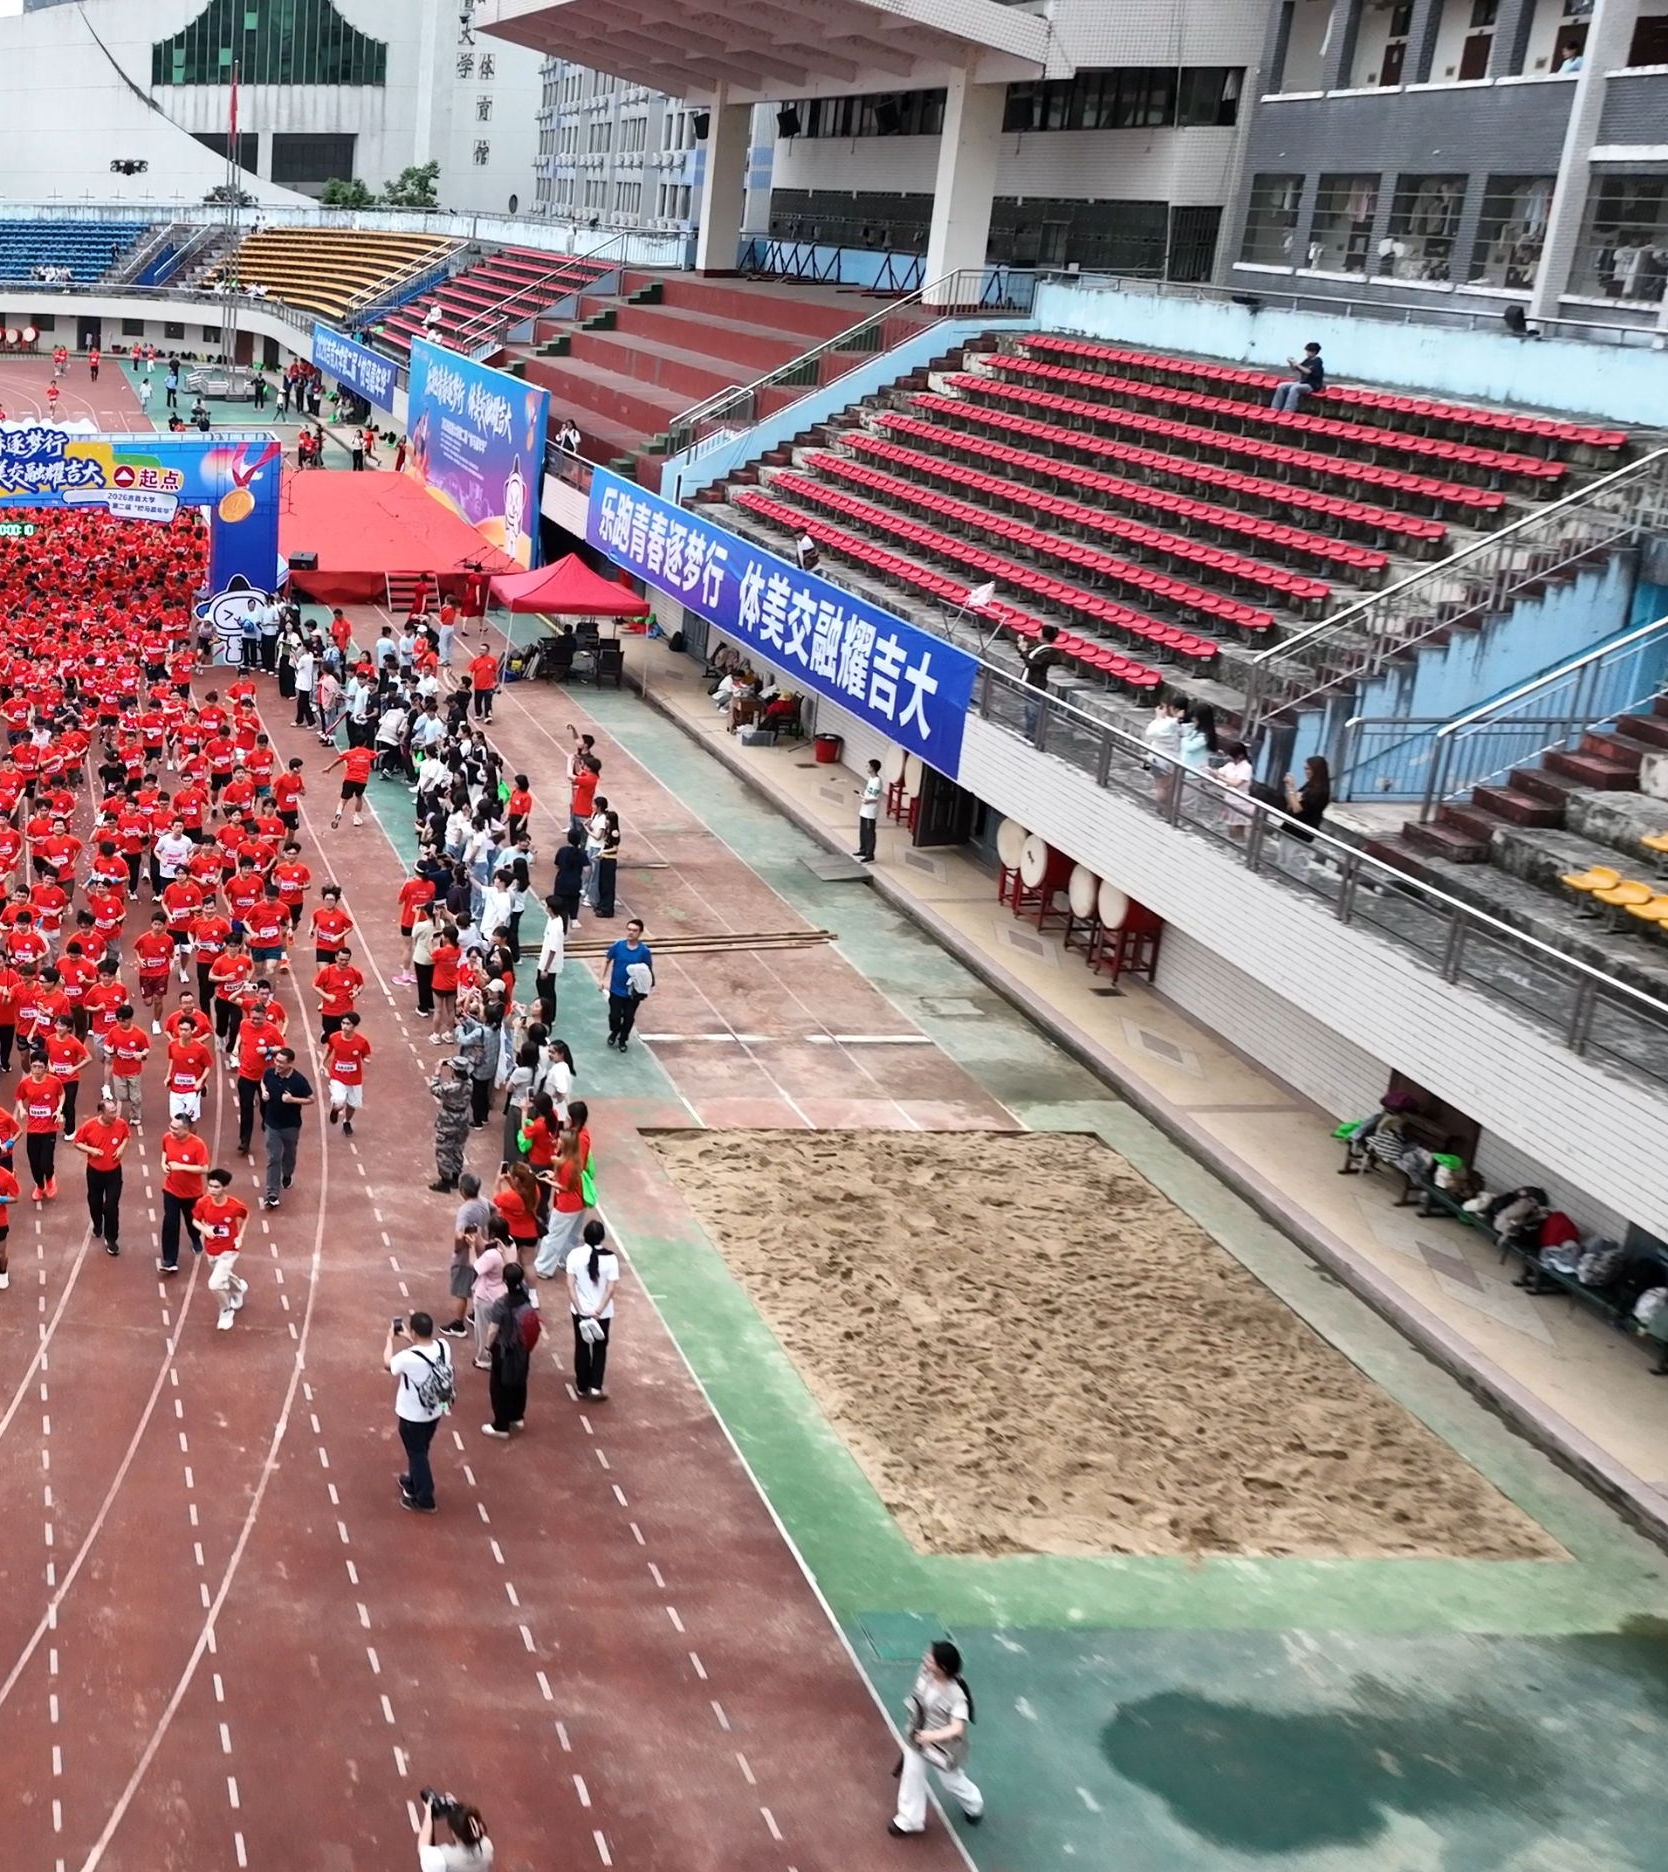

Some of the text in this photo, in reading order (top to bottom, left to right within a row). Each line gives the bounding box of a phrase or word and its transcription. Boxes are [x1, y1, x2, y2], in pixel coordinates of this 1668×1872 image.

[473, 53, 495, 165] 体育馆
[139, 468, 180, 490] 起点
[598, 487, 939, 741] 乐跑青春逐梦行 体美交融耀吉大
